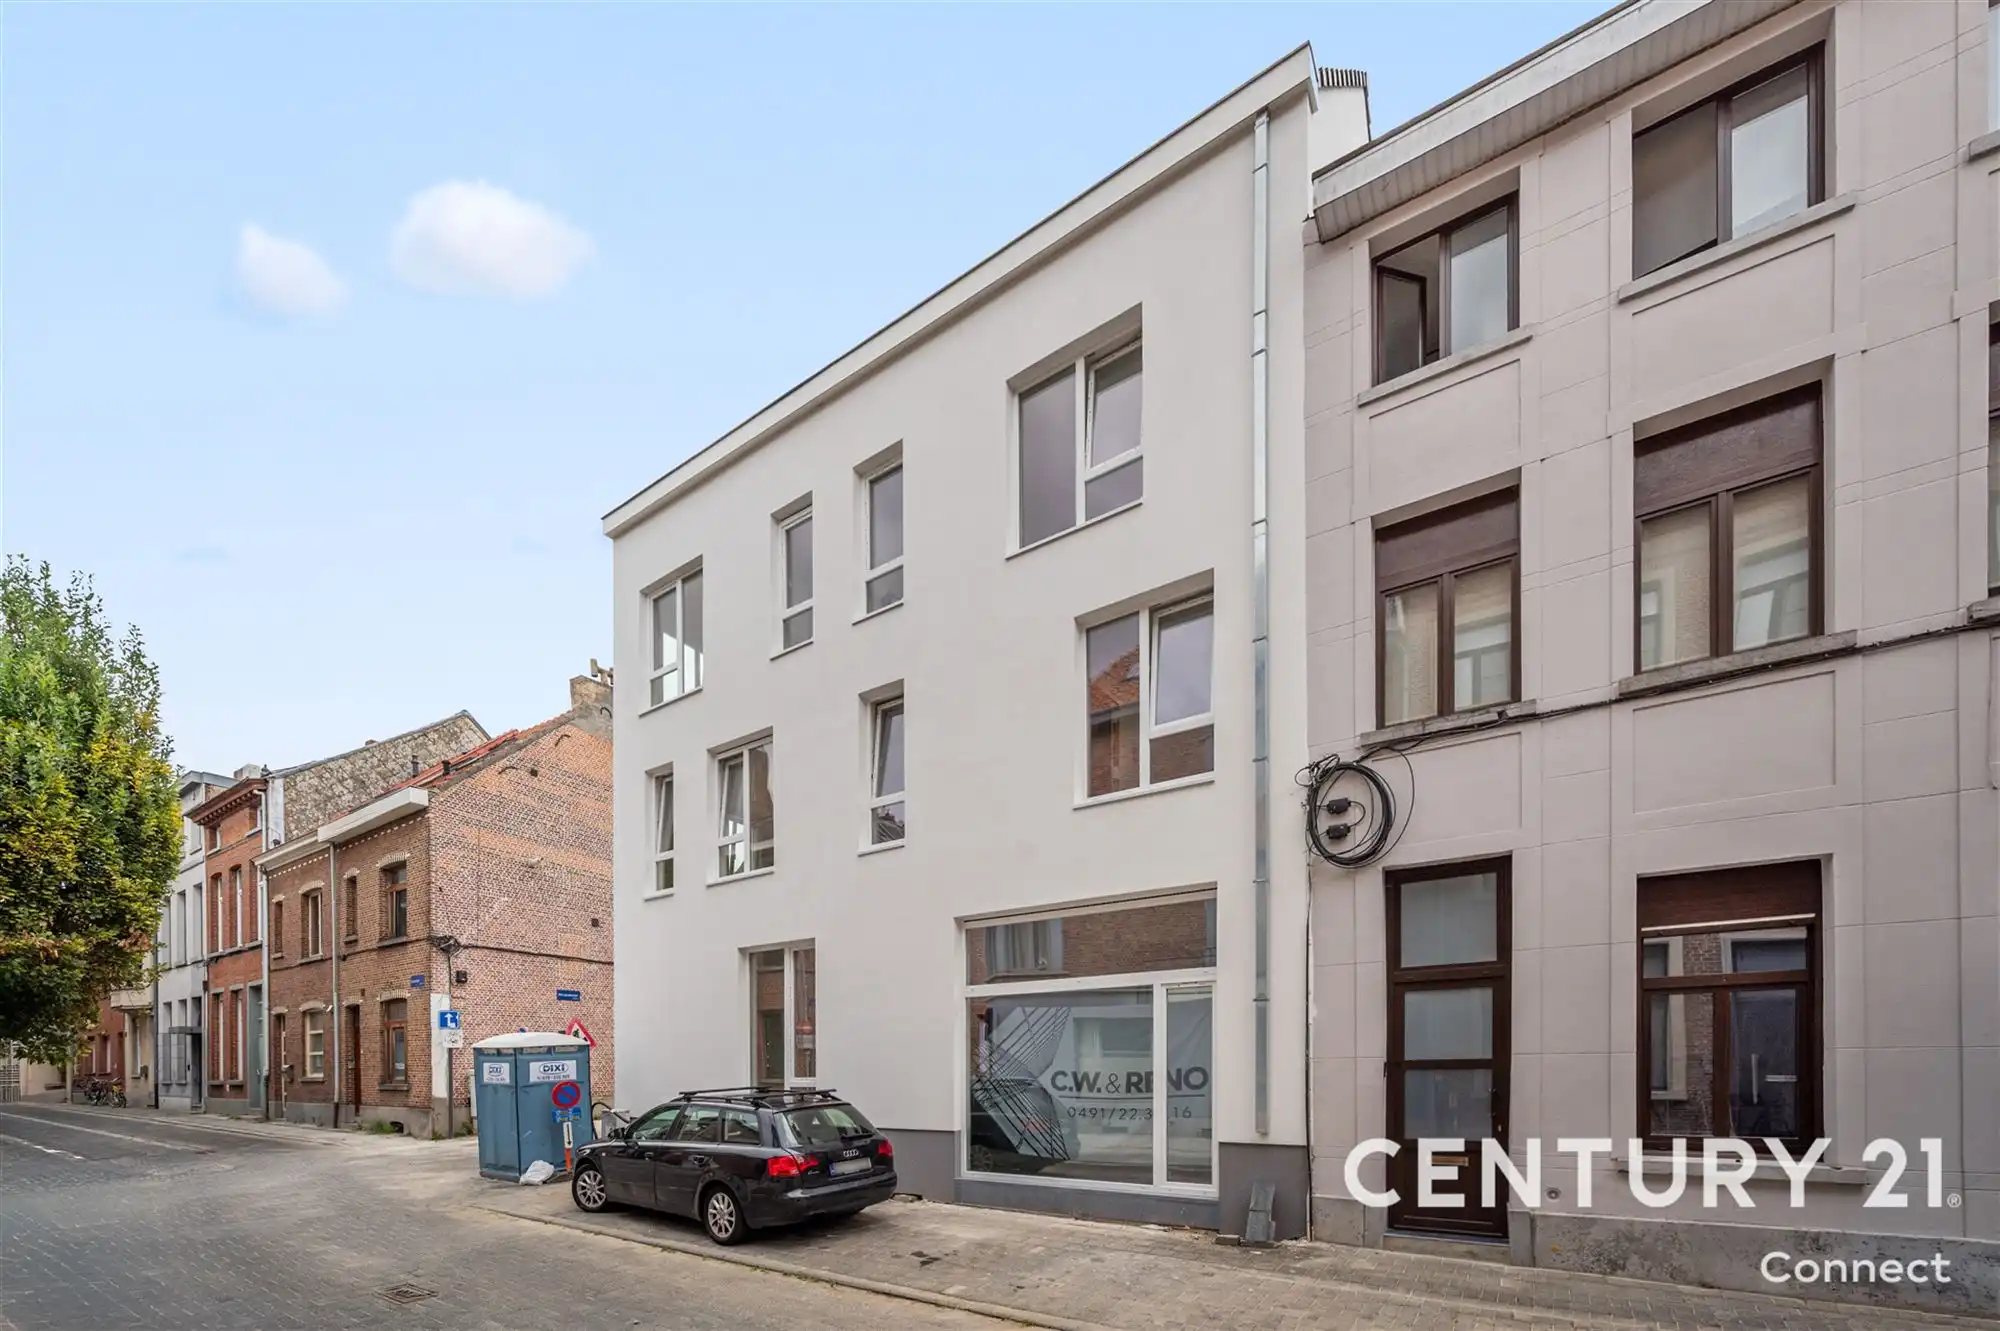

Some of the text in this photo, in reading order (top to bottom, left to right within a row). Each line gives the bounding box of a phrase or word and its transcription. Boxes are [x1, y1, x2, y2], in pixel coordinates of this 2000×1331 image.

[543, 1063, 565, 1072] DIXI
[1050, 1070, 1102, 1094] C.W.
[1105, 1072, 1121, 1094] &
